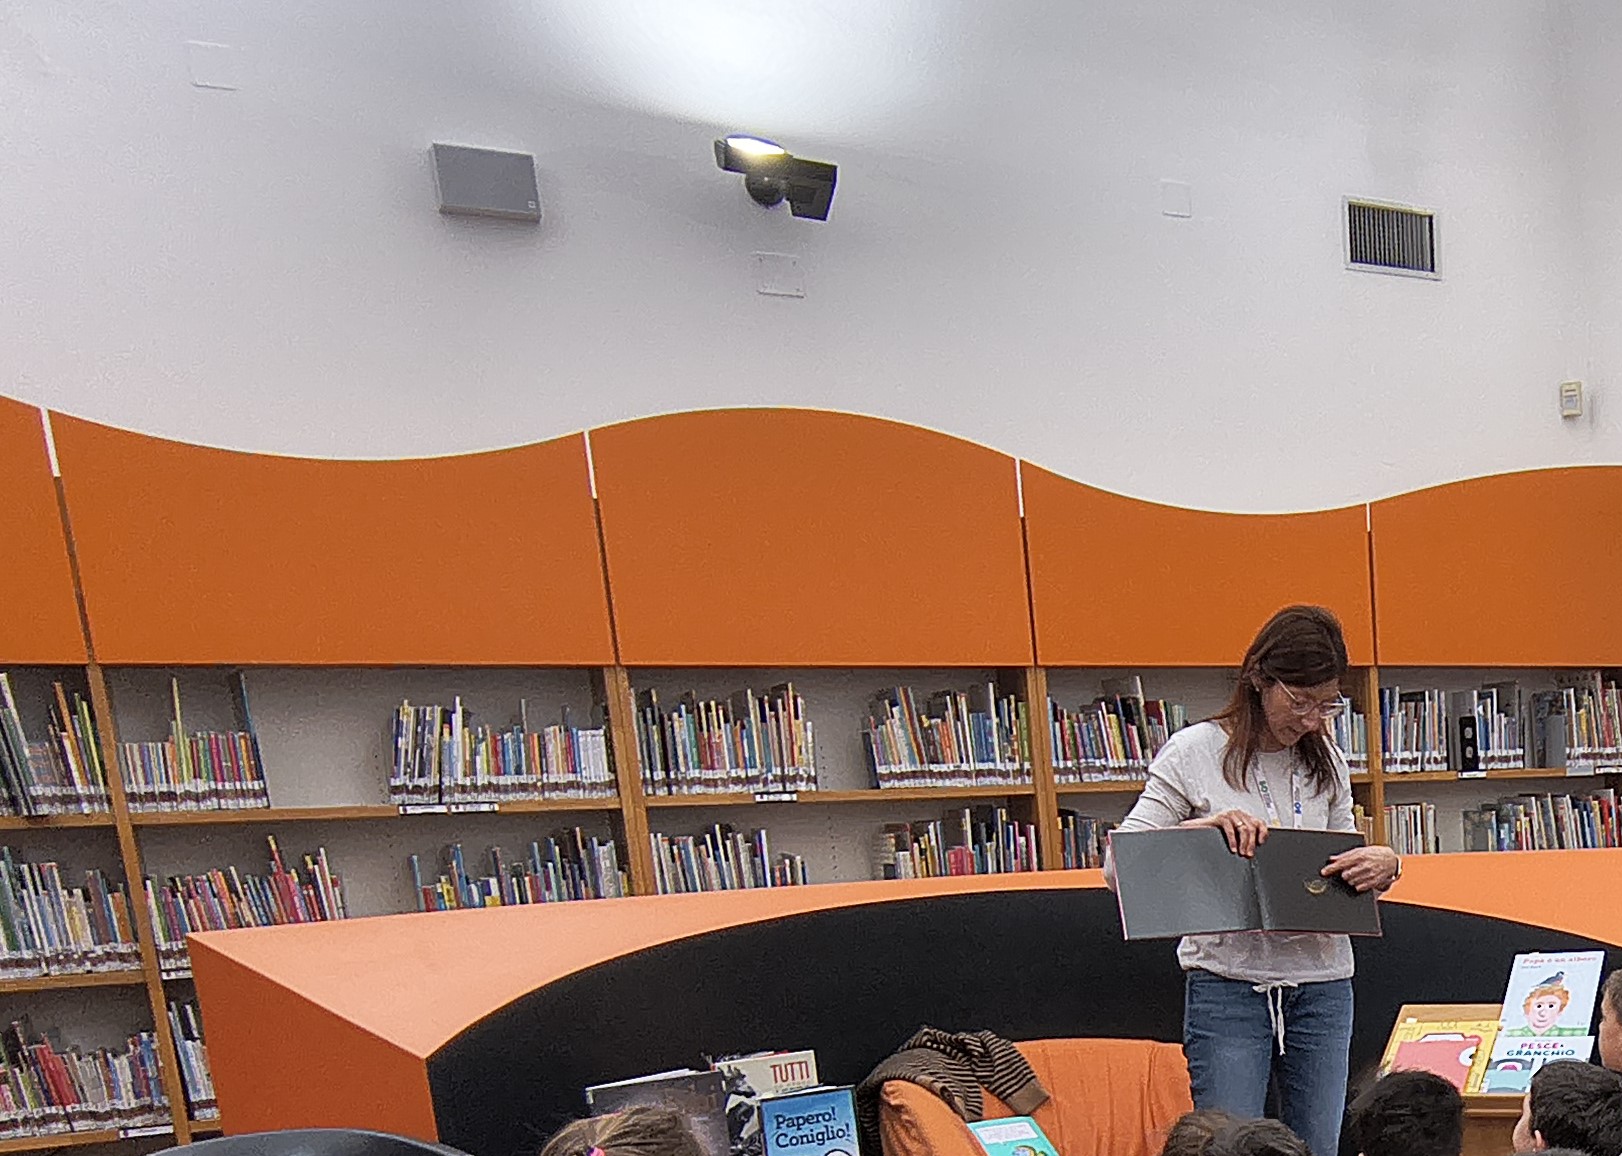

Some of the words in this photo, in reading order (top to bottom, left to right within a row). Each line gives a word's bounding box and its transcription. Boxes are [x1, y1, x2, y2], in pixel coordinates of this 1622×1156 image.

[1520, 1042, 1559, 1050] PESCE
[769, 1060, 810, 1084] TUTTI
[774, 1105, 837, 1131] Papero!
[775, 1122, 851, 1148] Coniglio!
